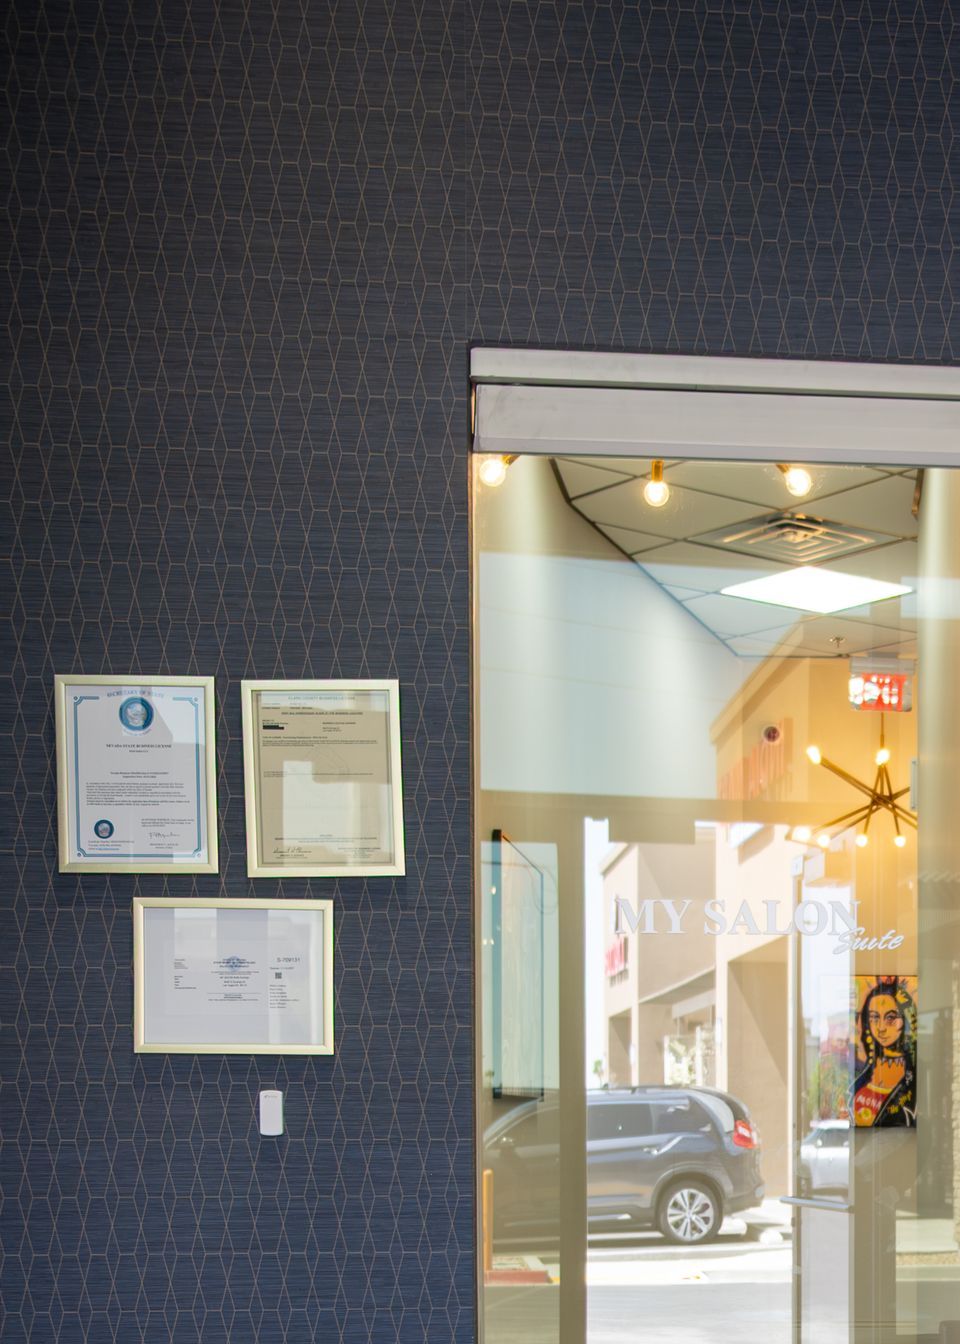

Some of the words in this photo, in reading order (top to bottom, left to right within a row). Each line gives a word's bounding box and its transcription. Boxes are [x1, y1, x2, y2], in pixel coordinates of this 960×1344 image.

[615, 898, 693, 935] MY
[703, 898, 861, 936] SALON
[832, 926, 905, 955] Suite
